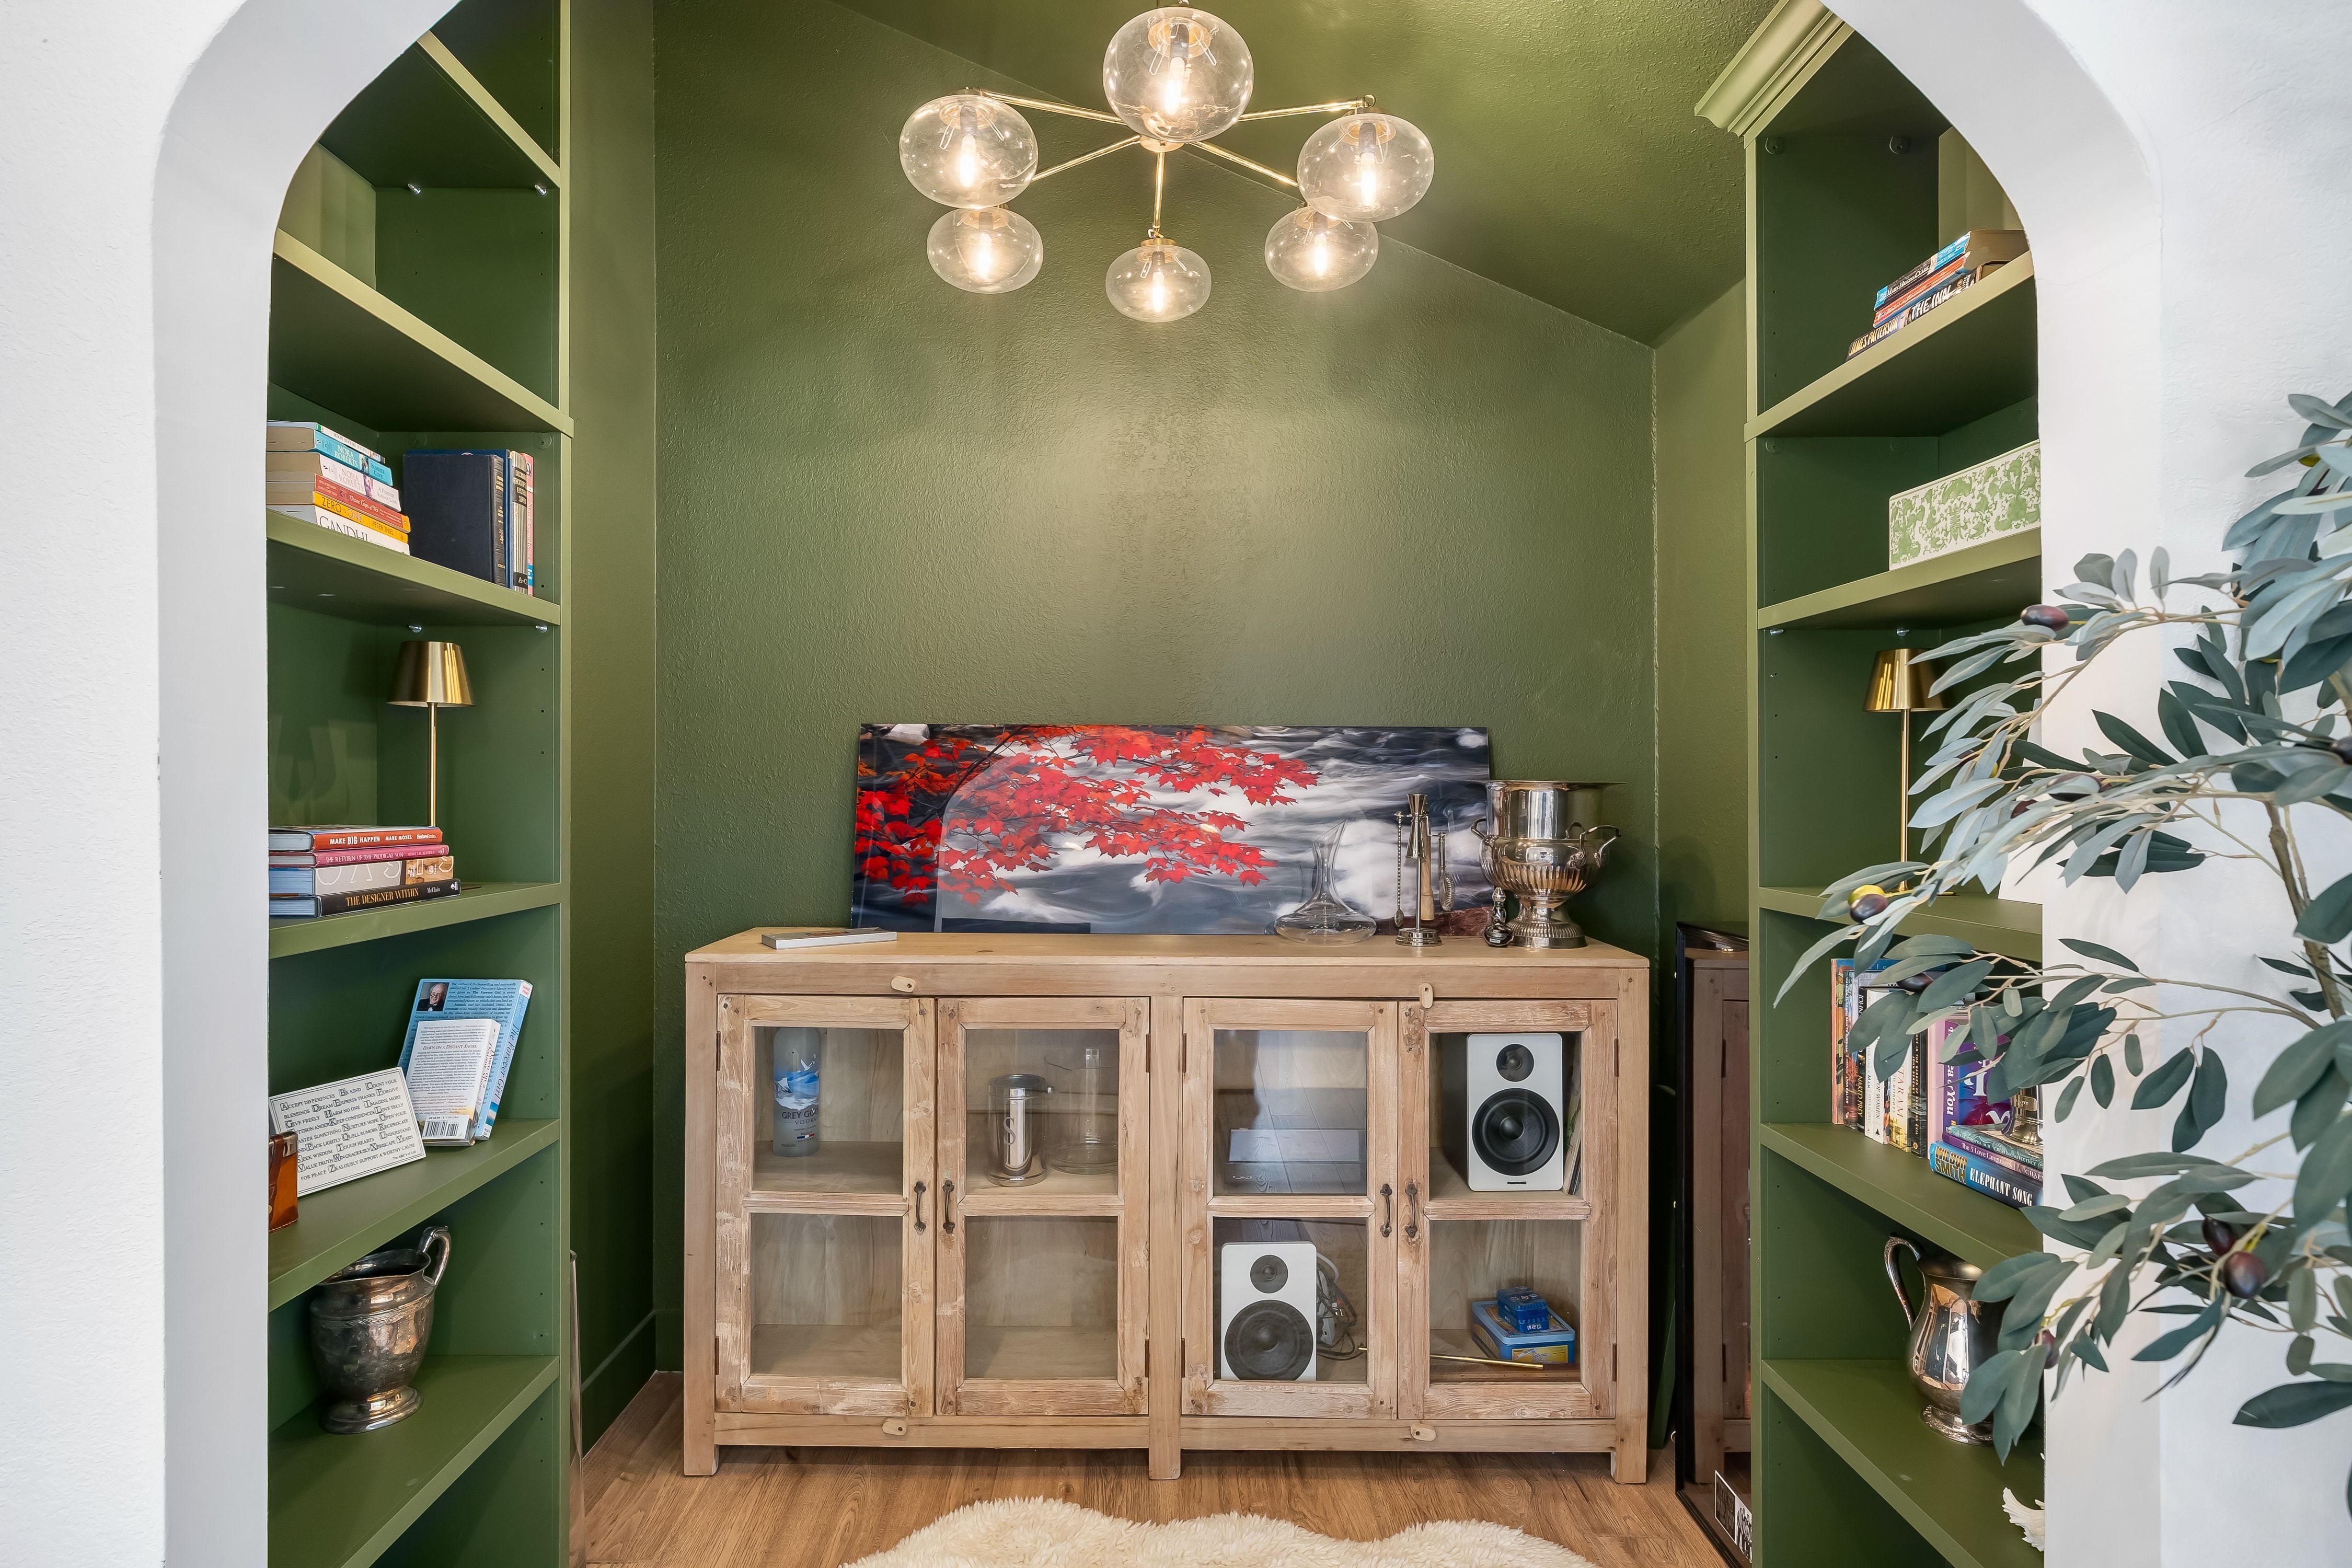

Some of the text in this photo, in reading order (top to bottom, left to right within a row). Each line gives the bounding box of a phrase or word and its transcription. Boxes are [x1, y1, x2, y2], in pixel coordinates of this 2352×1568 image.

[1911, 296, 1931, 320] THE
[1849, 316, 1899, 356] JAMES PATTERSON
[335, 451, 358, 468] ROBERTS
[338, 445, 354, 459] NORA
[339, 474, 364, 492] ROBERTS
[342, 469, 359, 482] NORA
[319, 516, 367, 541] GANDHI
[321, 497, 342, 513] ZERO
[347, 509, 363, 523] ONE
[372, 521, 384, 532] PETER
[384, 526, 394, 536] THIEL
[347, 836, 358, 845] BIG
[345, 896, 361, 906] THE
[362, 891, 394, 904] DESIGNER
[395, 887, 419, 898] WITHIN
[494, 1024, 520, 1100] The Forever Girl
[280, 1101, 303, 1111] ACCEPT
[304, 1094, 335, 1104] DIFFERENCES
[339, 1088, 349, 1097] BE
[365, 1082, 385, 1090] COUNT
[1876, 1083, 1881, 1092] OF
[284, 1109, 310, 1119] BLESSINGS
[312, 1103, 333, 1113] DREAM
[333, 1097, 357, 1107] EXPRESS
[376, 1087, 399, 1097] FORGIVE
[284, 1120, 302, 1128] GIVE
[324, 1109, 342, 1118] HARM
[363, 1099, 388, 1108] IMAGINE
[804, 1108, 818, 1117] GOO
[1947, 1090, 1955, 1115] You
[314, 1129, 341, 1139] SOMETHING
[342, 1123, 366, 1132] NURTURE
[379, 1113, 394, 1122] OPEN
[329, 1117, 344, 1126] KEEP
[345, 1111, 375, 1122] CONFIDENCES
[374, 1106, 390, 1114] LOVE
[305, 1143, 322, 1151] PACK
[323, 1137, 341, 1146] LIGHTLY
[342, 1133, 360, 1141] QUELL
[378, 1119, 408, 1131] RECIPROCATE
[313, 1150, 332, 1158] WISDOM
[336, 1143, 356, 1152] TOUCH
[379, 1127, 411, 1139] UNDERSTAND
[1004, 1116, 1016, 1145] S
[298, 1163, 317, 1172] VALUE
[333, 1154, 345, 1162] WIN
[345, 1147, 371, 1158] GRACIOUSLY
[370, 1140, 396, 1151] XERISCAPE
[396, 1135, 413, 1144] YEARN
[328, 1160, 359, 1173] ZEALOUSLY
[383, 1148, 401, 1156] WORTHY
[1935, 1145, 1968, 1170] WILBUR
[1974, 1148, 1986, 1157] Love
[1987, 1152, 2012, 1169] Languages
[2025, 1170, 2043, 1180] CHAP
[1935, 1159, 1968, 1185] SMITH
[1970, 1167, 2033, 1207] ELEPHANT SONG
